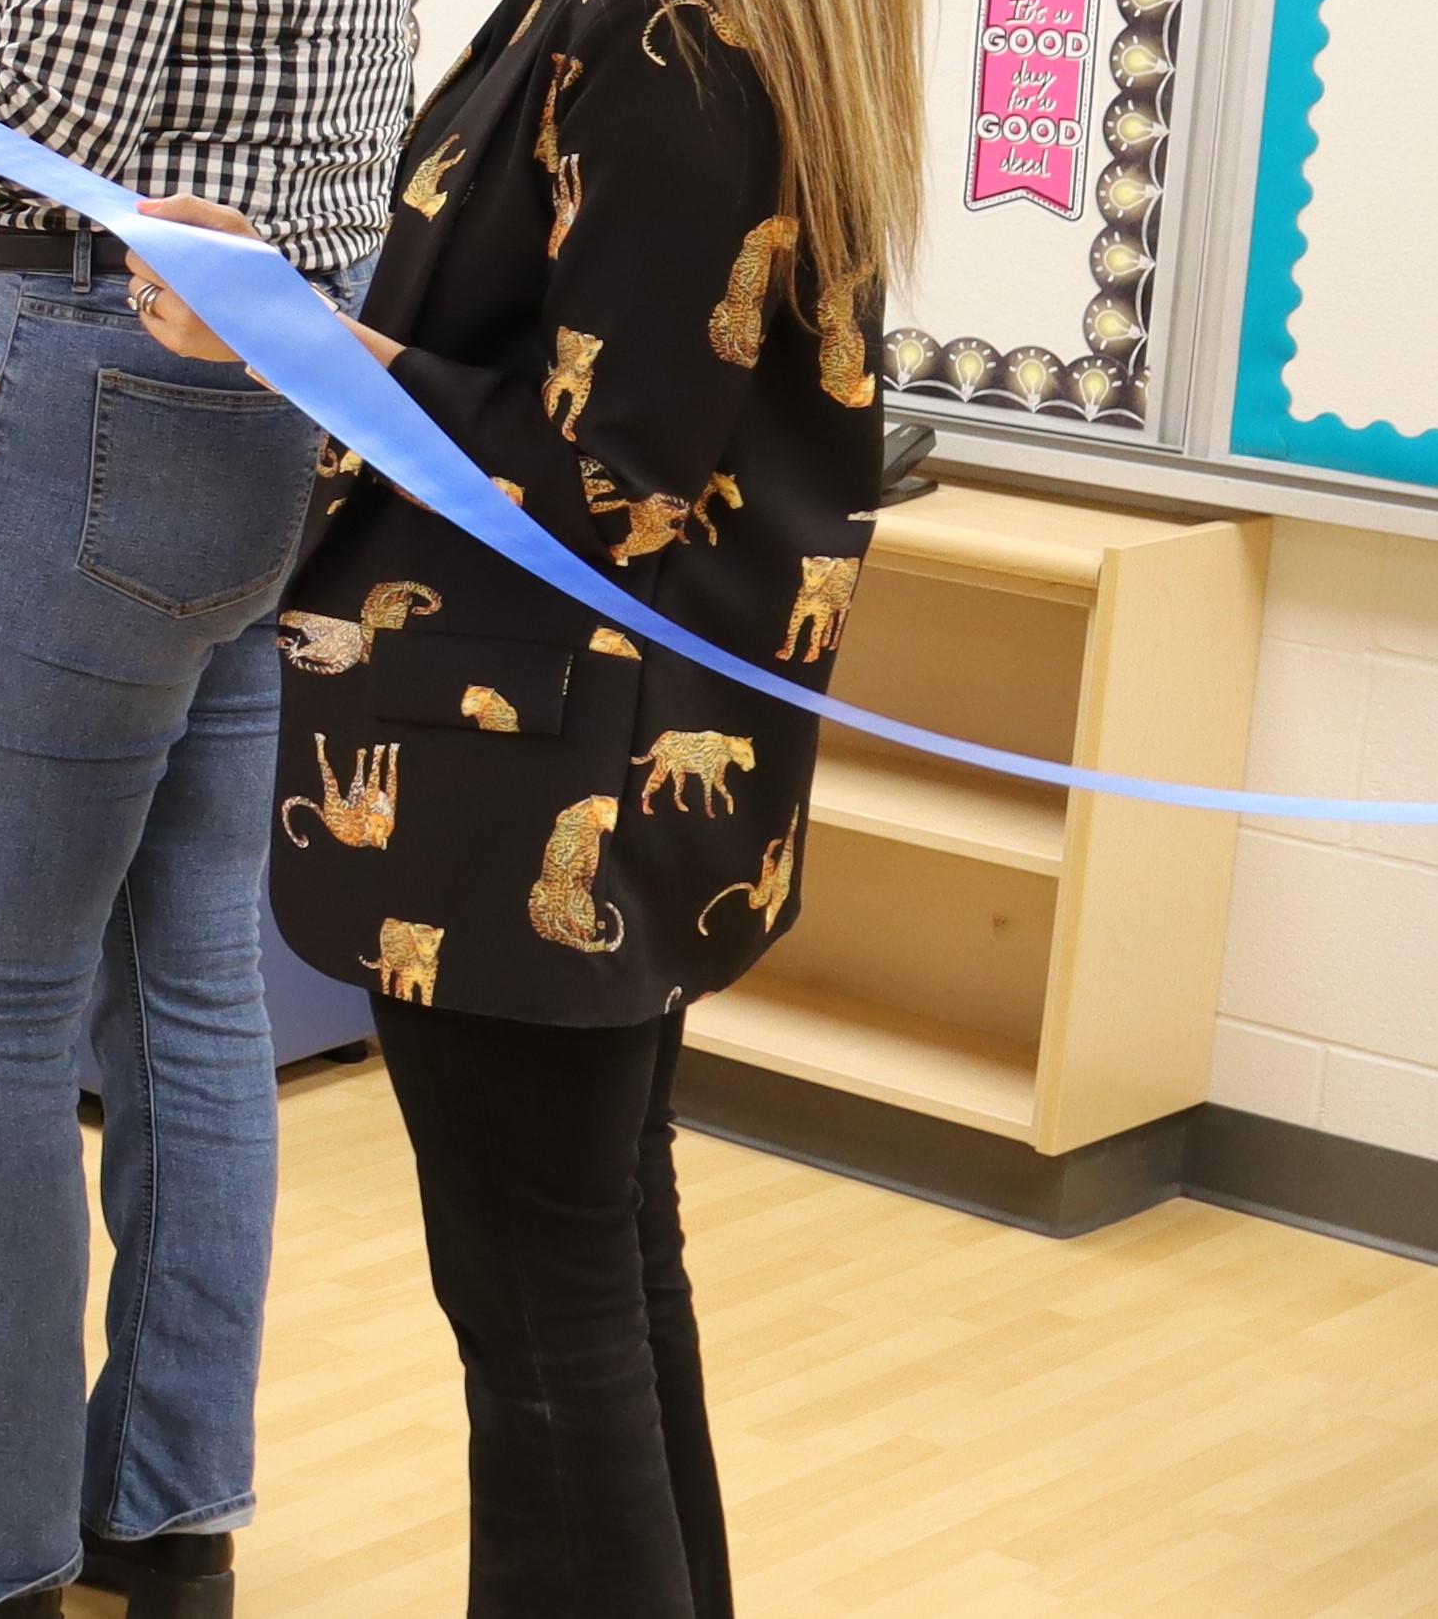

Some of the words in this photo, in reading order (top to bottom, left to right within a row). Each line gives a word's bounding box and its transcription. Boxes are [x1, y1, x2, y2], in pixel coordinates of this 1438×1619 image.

[1053, 9, 1074, 25] a
[981, 24, 1091, 60] GOOD
[1011, 59, 1058, 100] day
[1008, 87, 1037, 113] for
[1037, 97, 1058, 113] a
[974, 111, 1084, 147] GOOD
